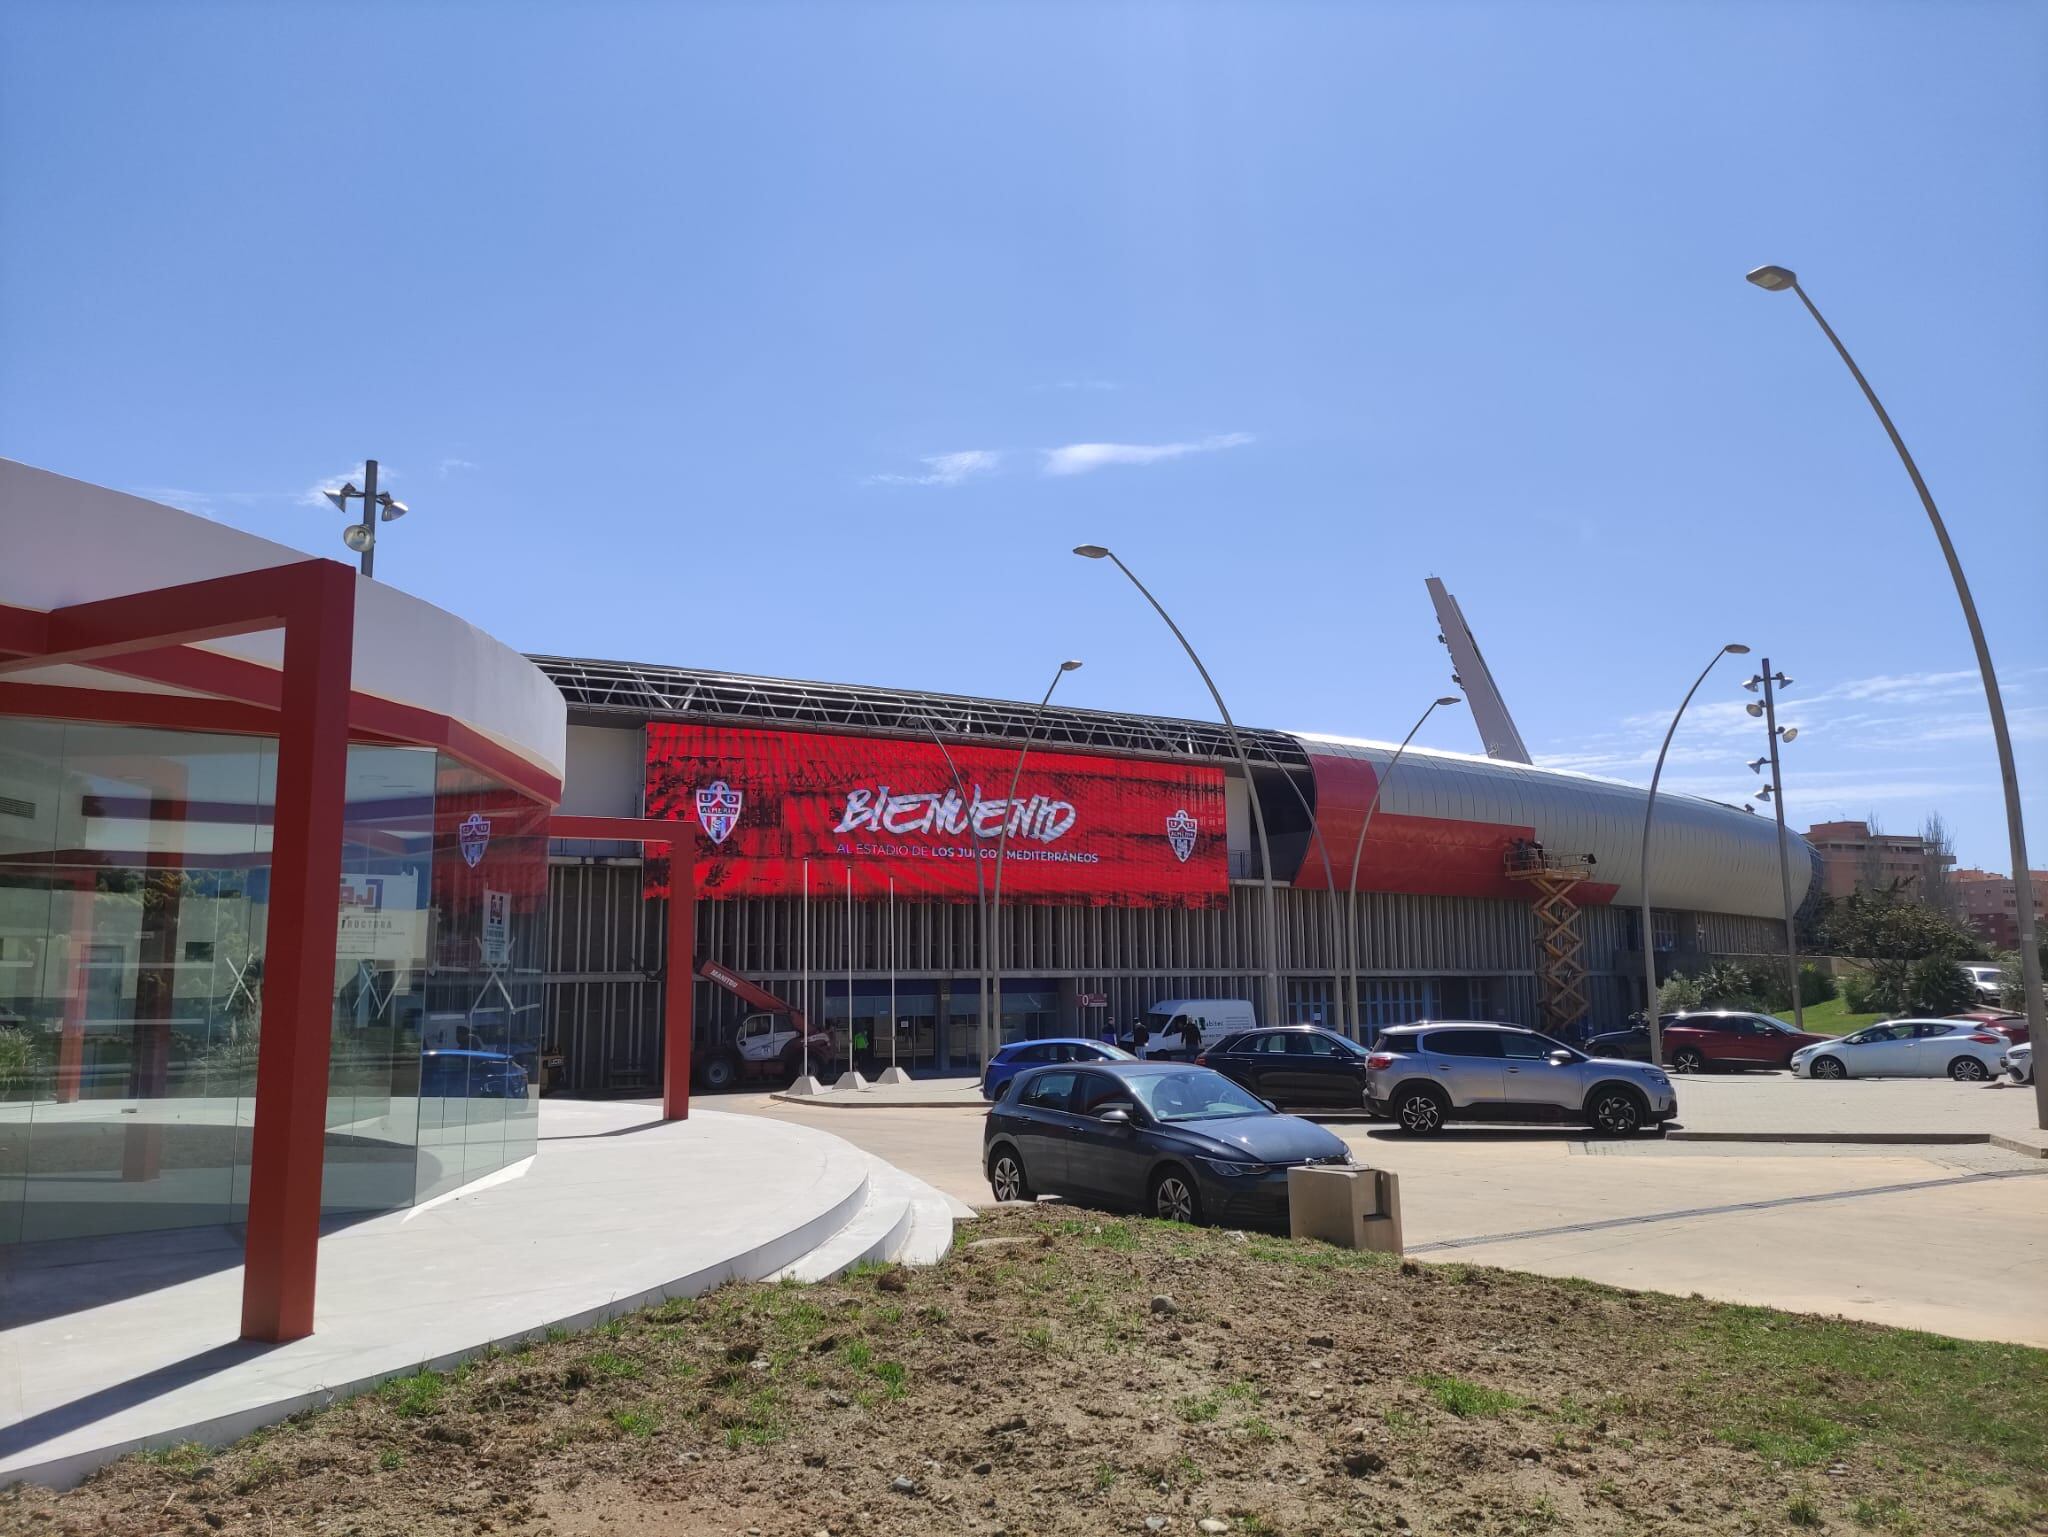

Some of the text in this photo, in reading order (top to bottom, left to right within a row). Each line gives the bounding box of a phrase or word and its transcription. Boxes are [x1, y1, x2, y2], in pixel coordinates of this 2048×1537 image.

[836, 844, 1098, 863] AL ESTADIO DE LOS JUGO MEDITERRÁNEOS
